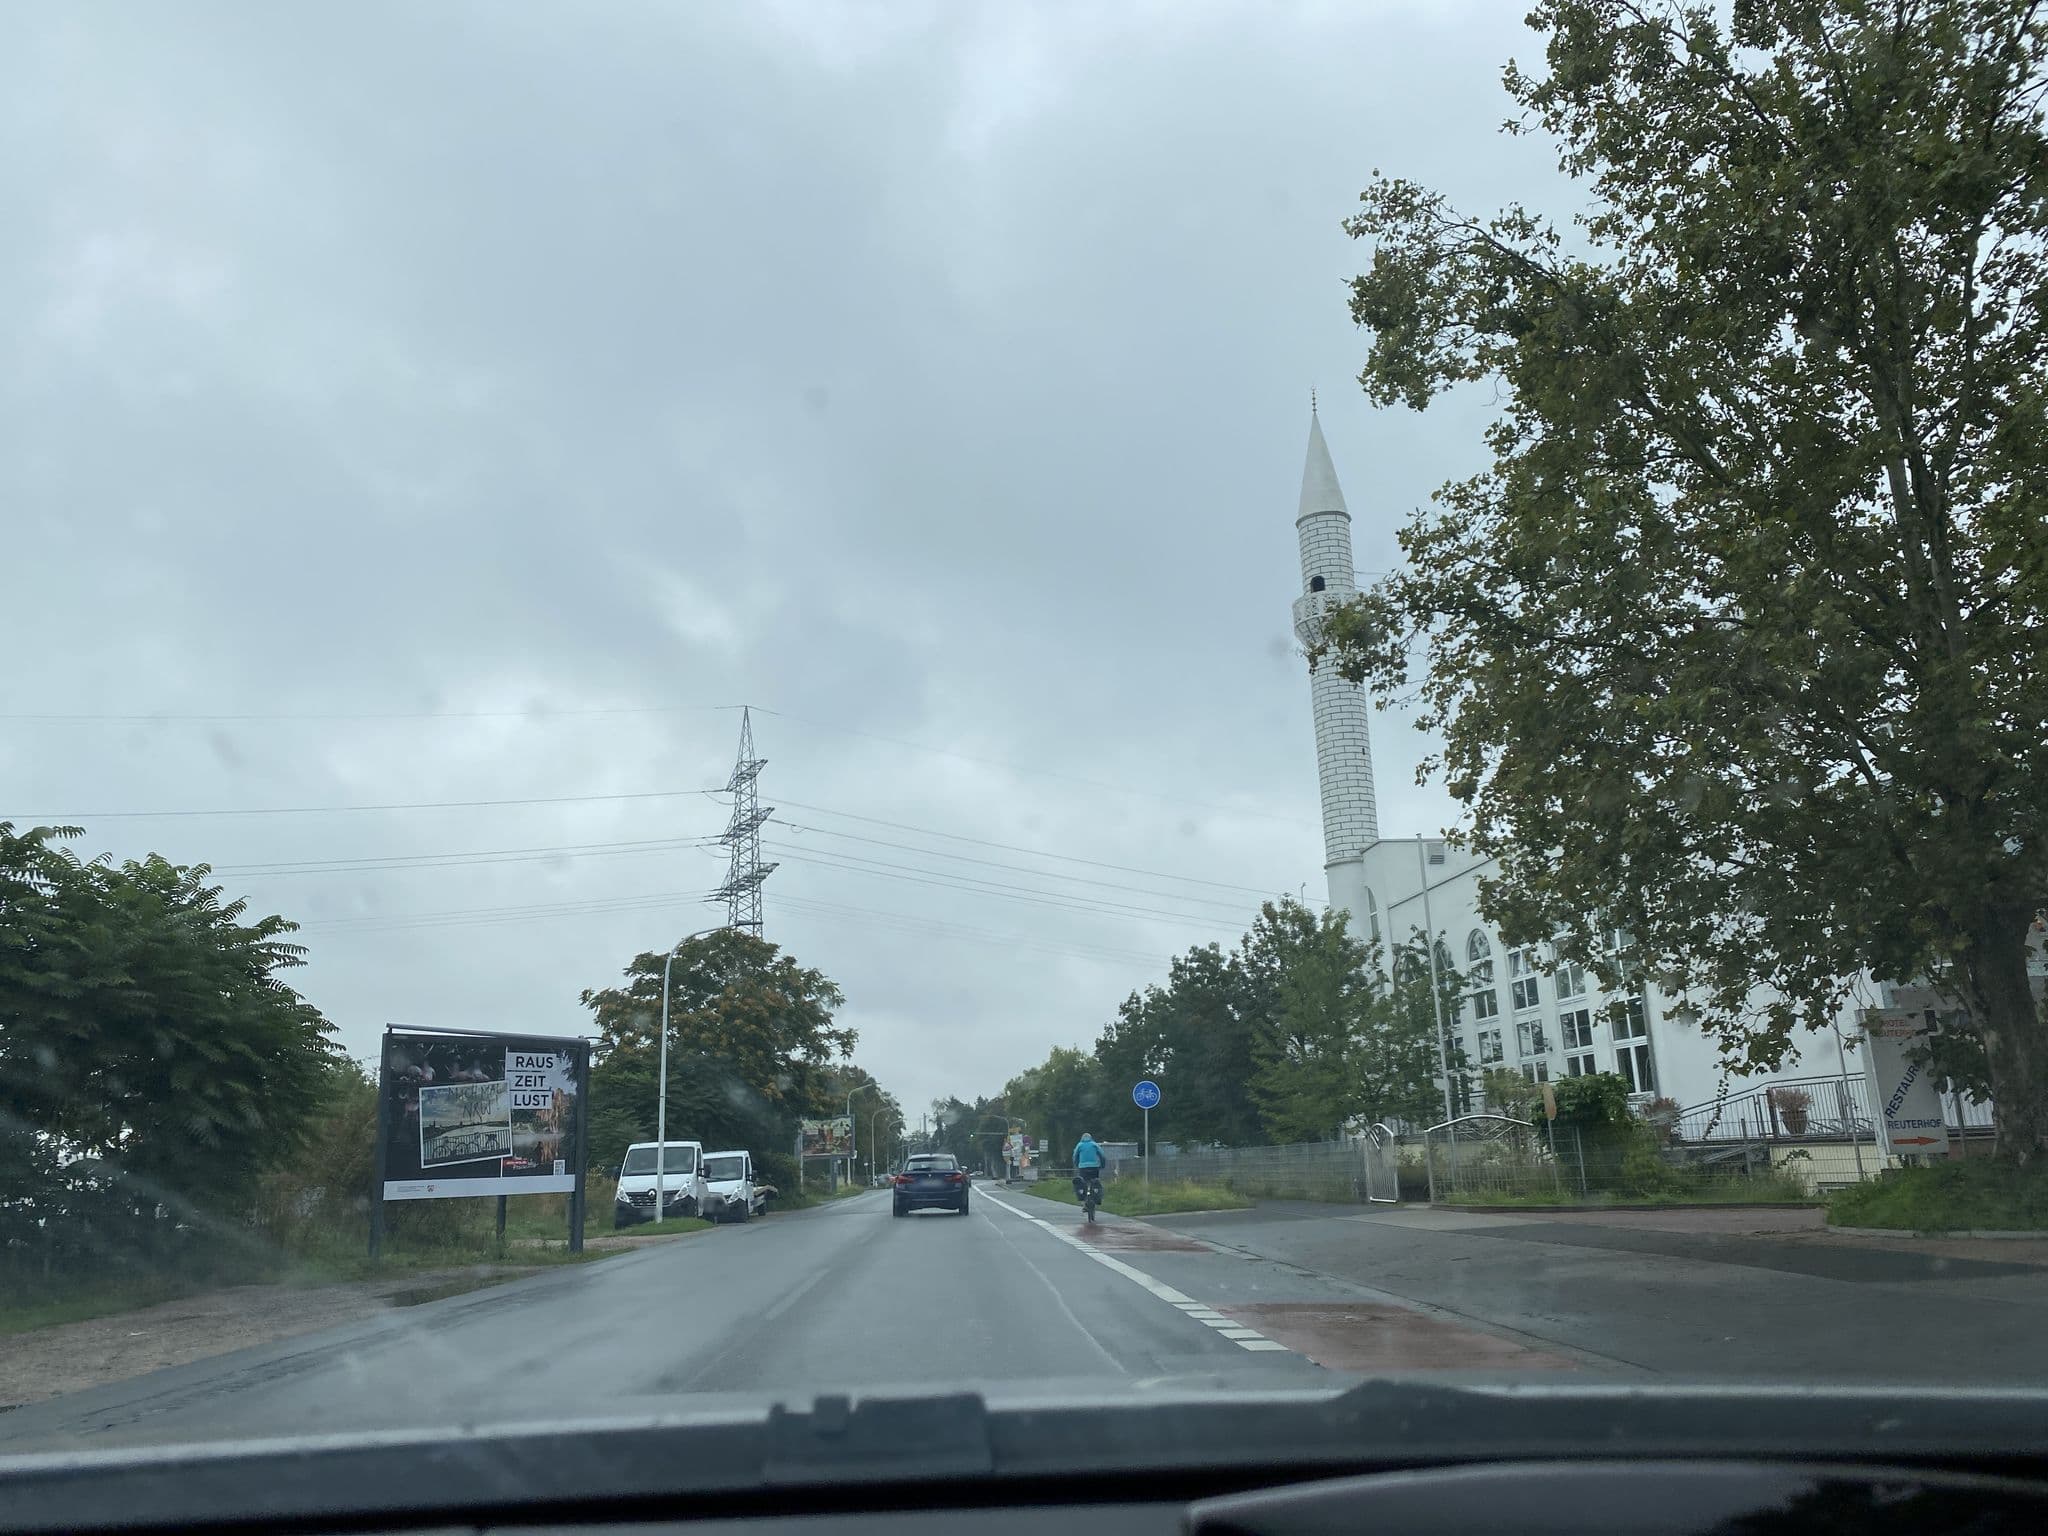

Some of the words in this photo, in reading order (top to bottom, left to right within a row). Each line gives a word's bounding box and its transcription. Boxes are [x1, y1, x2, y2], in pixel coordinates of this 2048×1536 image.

[515, 1055, 554, 1069] RAUS
[514, 1075, 546, 1087] ZEIT
[514, 1094, 550, 1107] LUST
[1887, 1118, 1942, 1129] REUTERHOF
